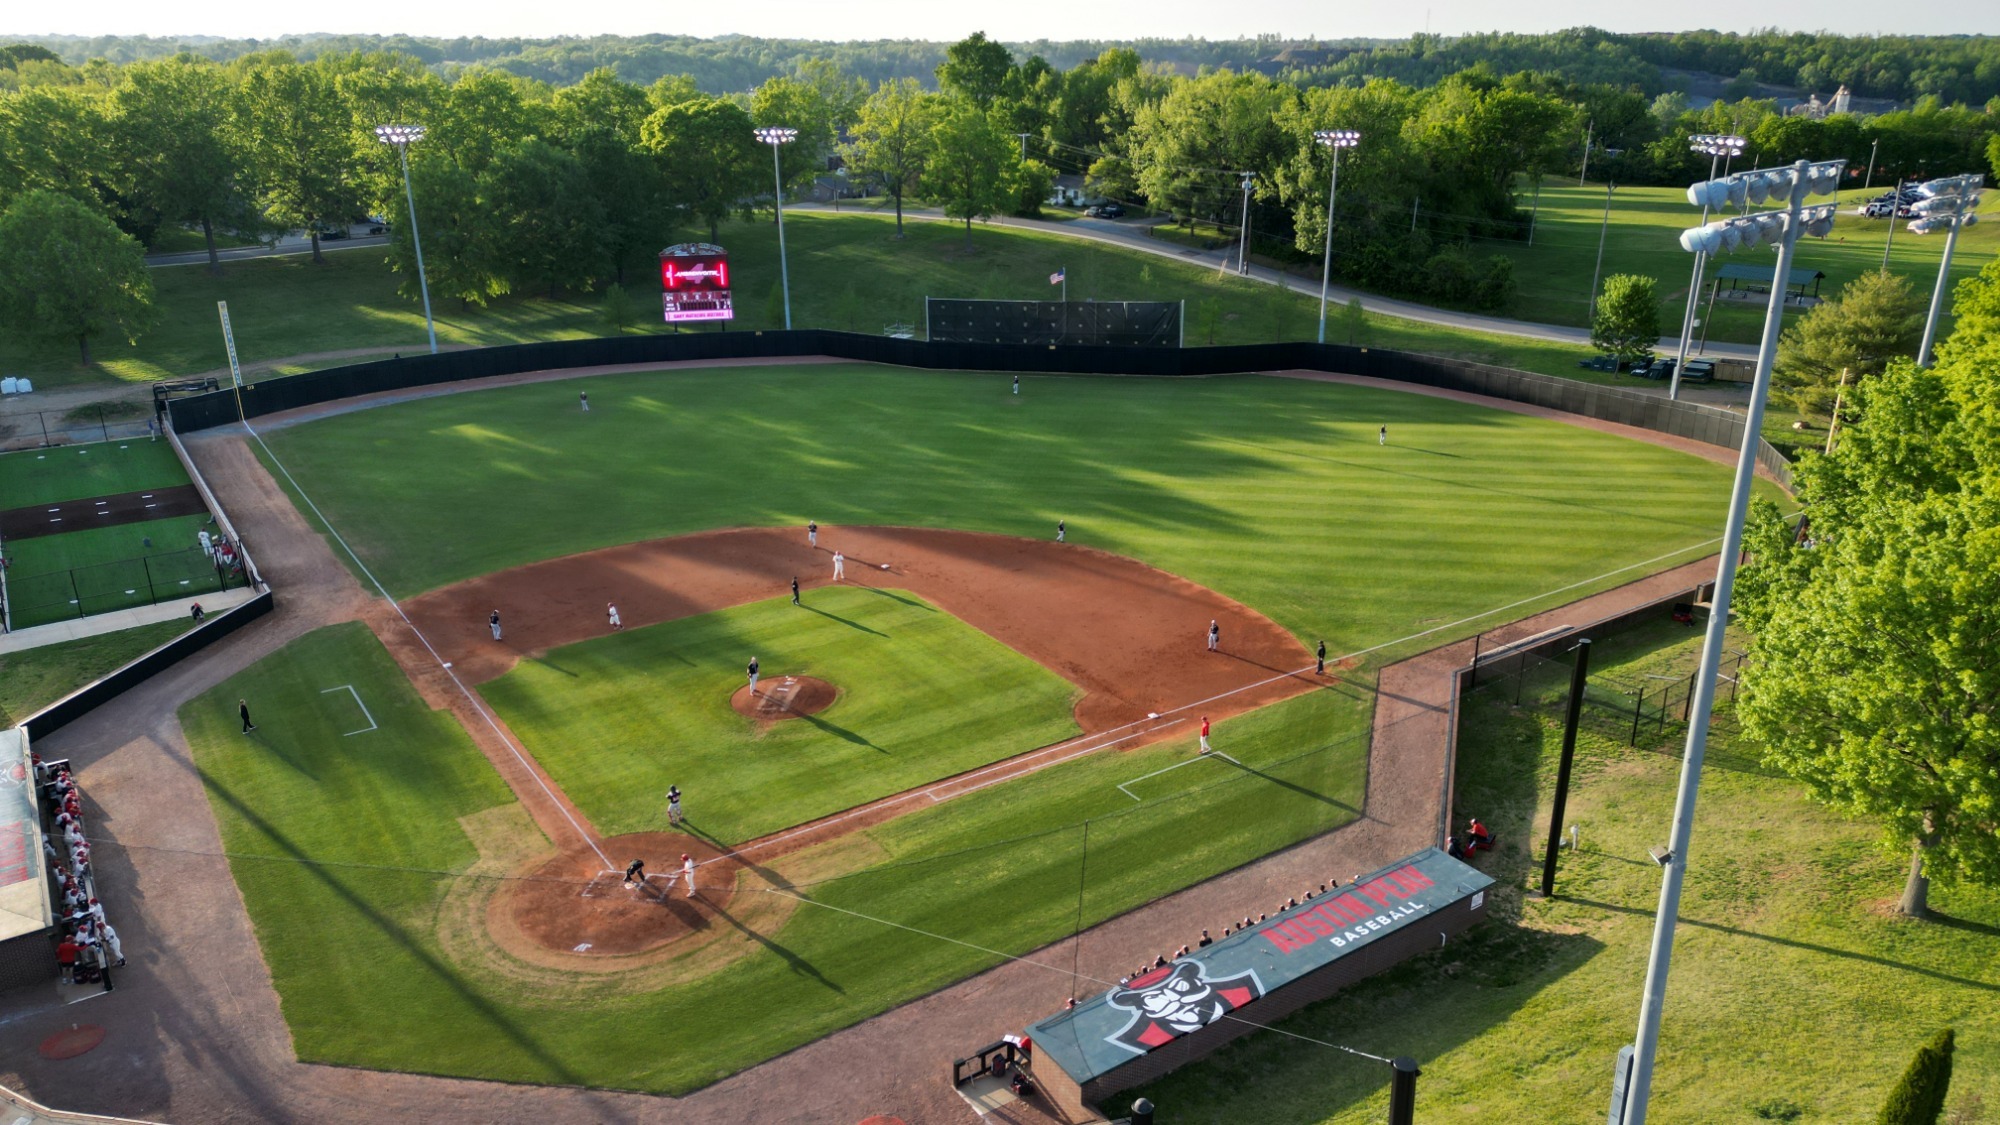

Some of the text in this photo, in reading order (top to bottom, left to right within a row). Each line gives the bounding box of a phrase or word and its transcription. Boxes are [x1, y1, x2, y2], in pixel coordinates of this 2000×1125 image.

[1259, 864, 1436, 955] AUSTIN PEAY
[1330, 901, 1424, 947] BASEBALL
